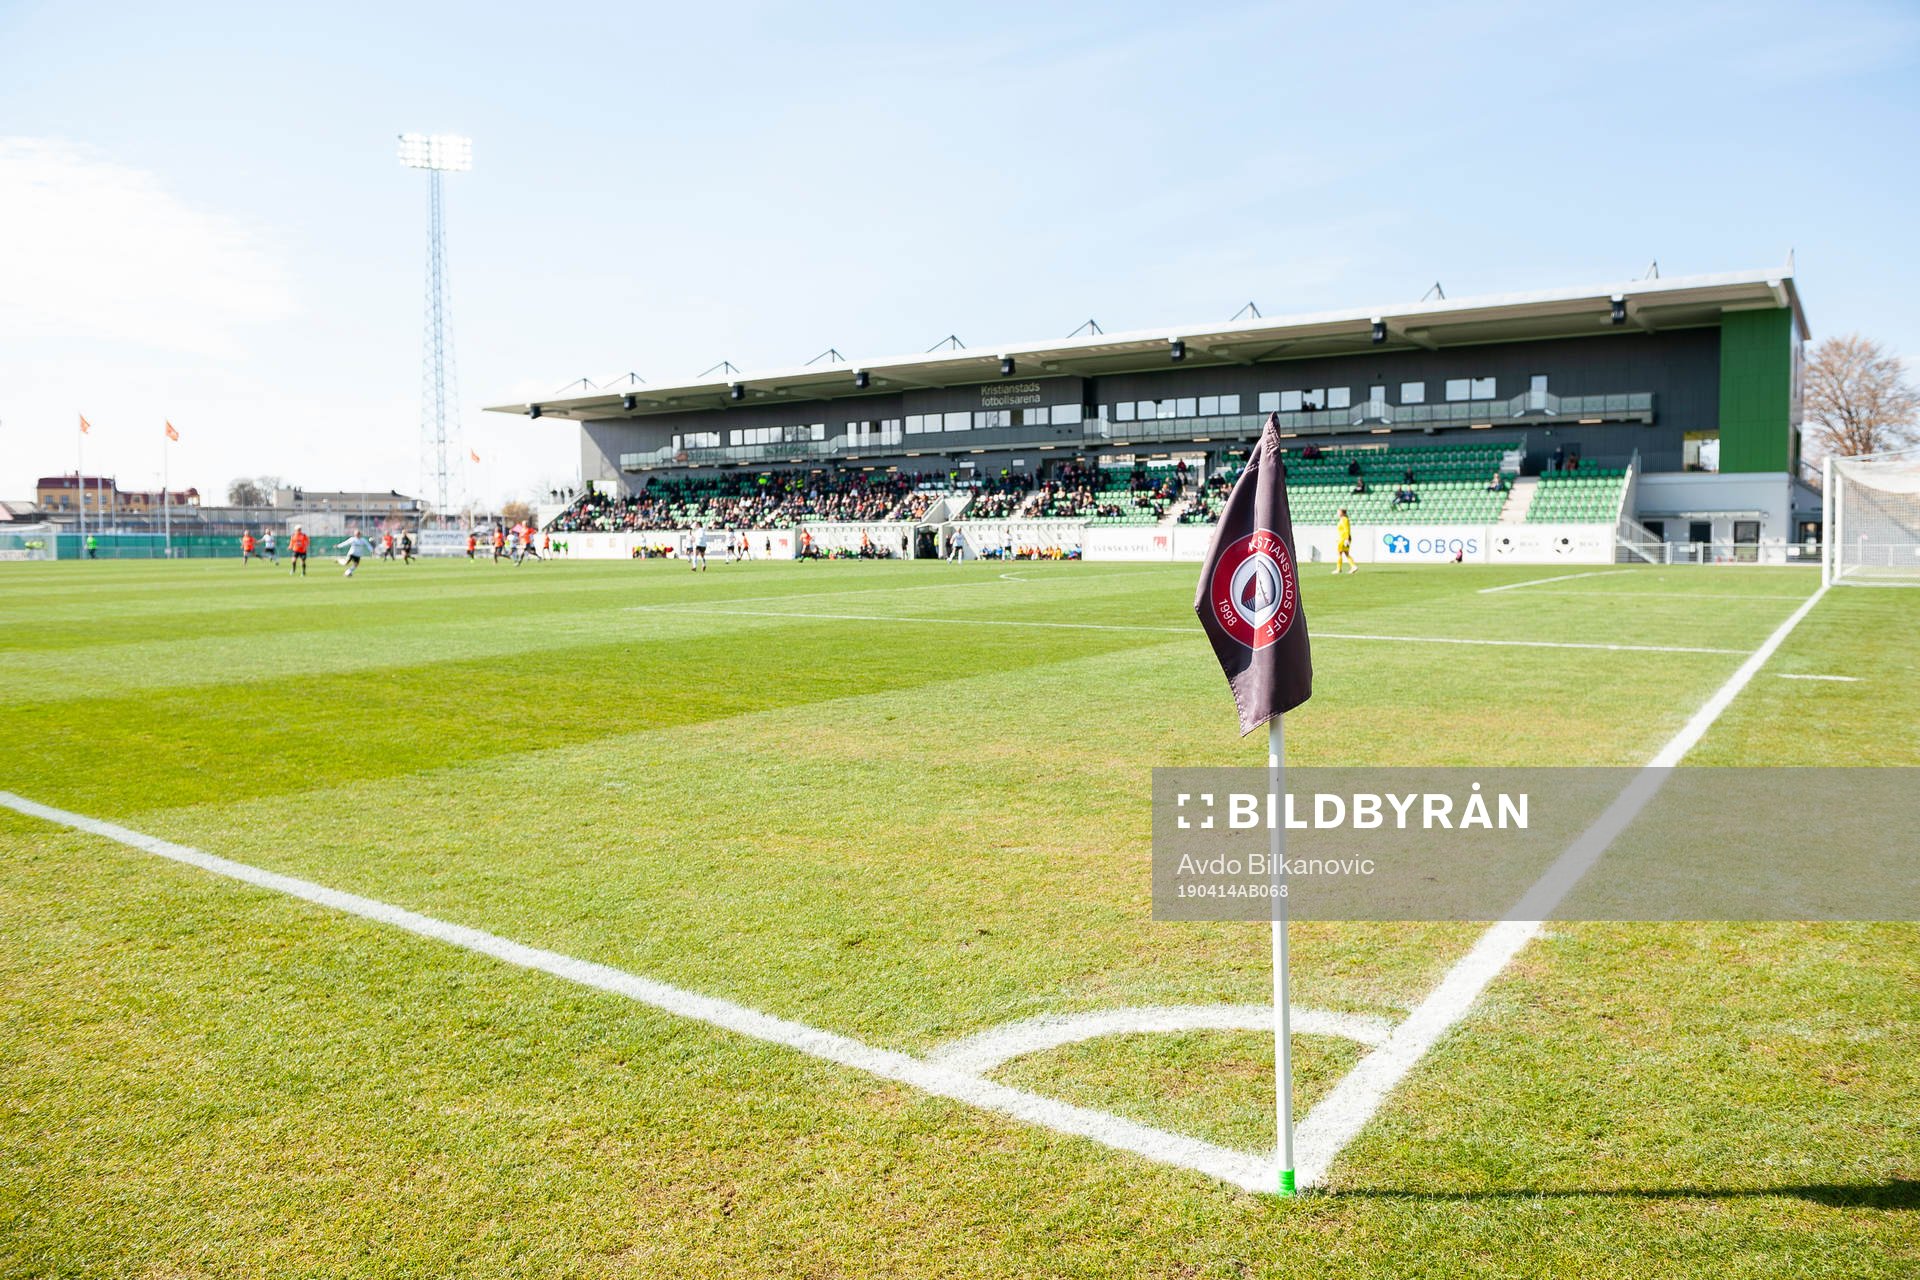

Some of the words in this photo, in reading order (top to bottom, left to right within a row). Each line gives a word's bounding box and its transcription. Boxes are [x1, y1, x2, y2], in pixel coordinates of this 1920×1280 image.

[981, 382, 1041, 396] Kristianstads
[981, 394, 1041, 407] fotbollsarena
[1417, 538, 1478, 554] OBOS
[1218, 597, 1238, 627] 1998
[1266, 612, 1288, 637] DFF
